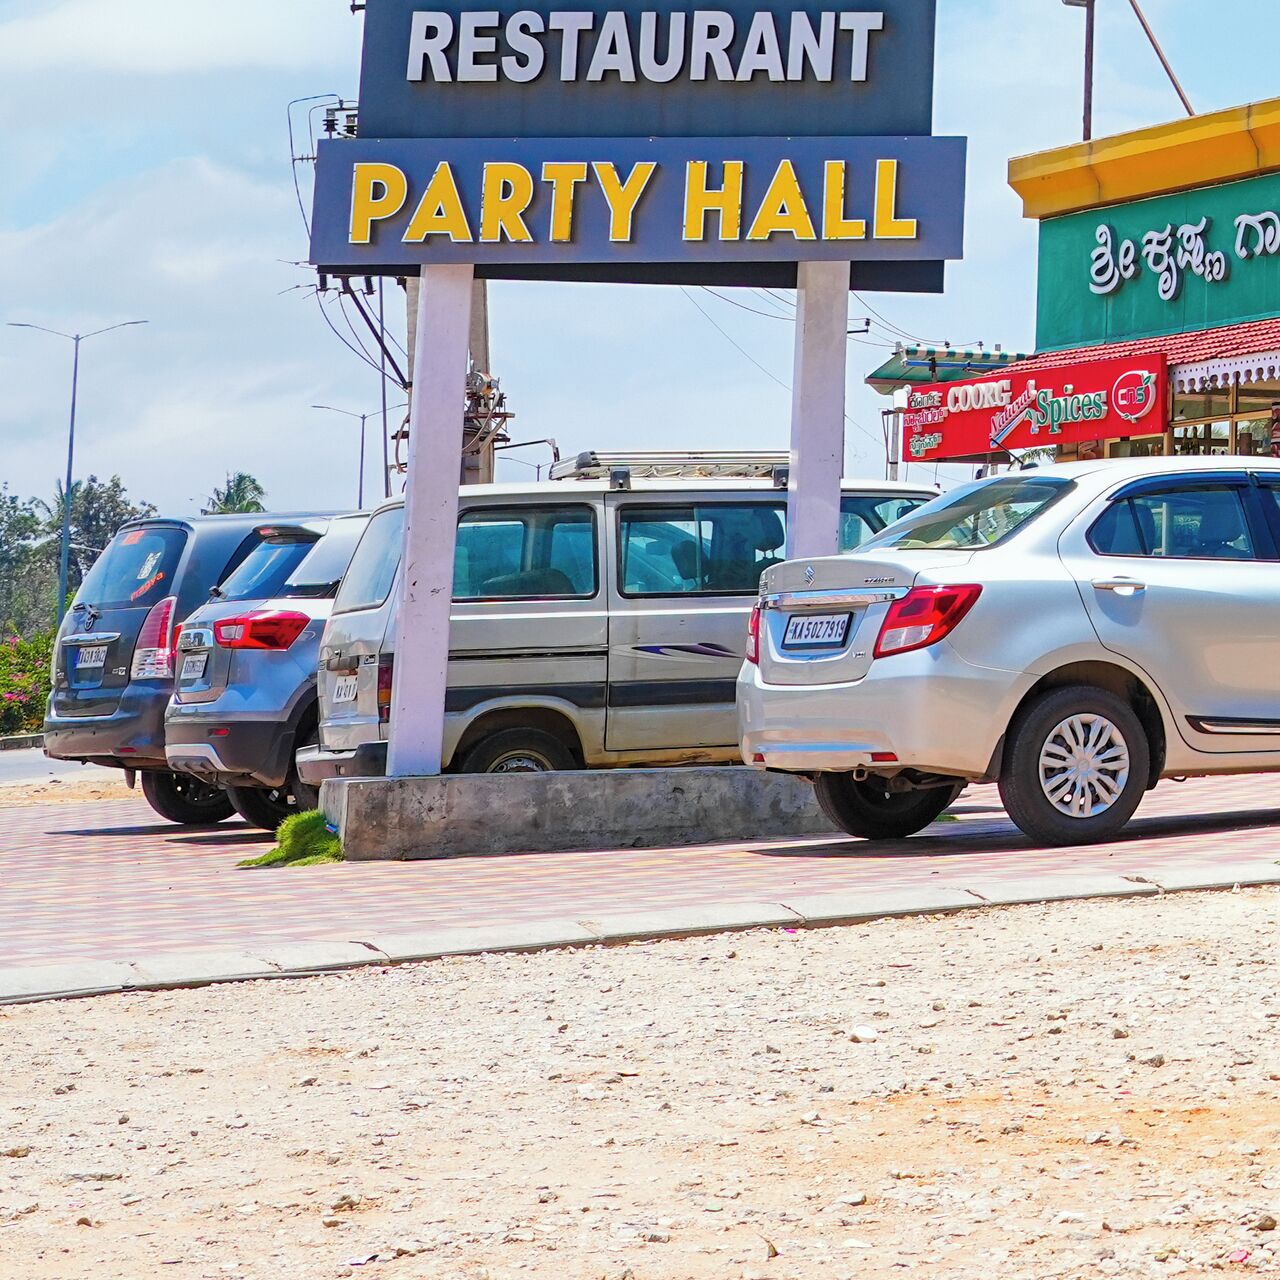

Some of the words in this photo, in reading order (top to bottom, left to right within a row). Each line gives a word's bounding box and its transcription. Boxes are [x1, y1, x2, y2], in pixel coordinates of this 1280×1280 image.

[405, 10, 884, 83] RESTAURANT
[348, 160, 658, 244] PARTY
[681, 158, 918, 242] HALL
[1088, 223, 1138, 296] ಶ್ರೀ
[946, 380, 1012, 412] COORG
[1036, 384, 1109, 434] Spices
